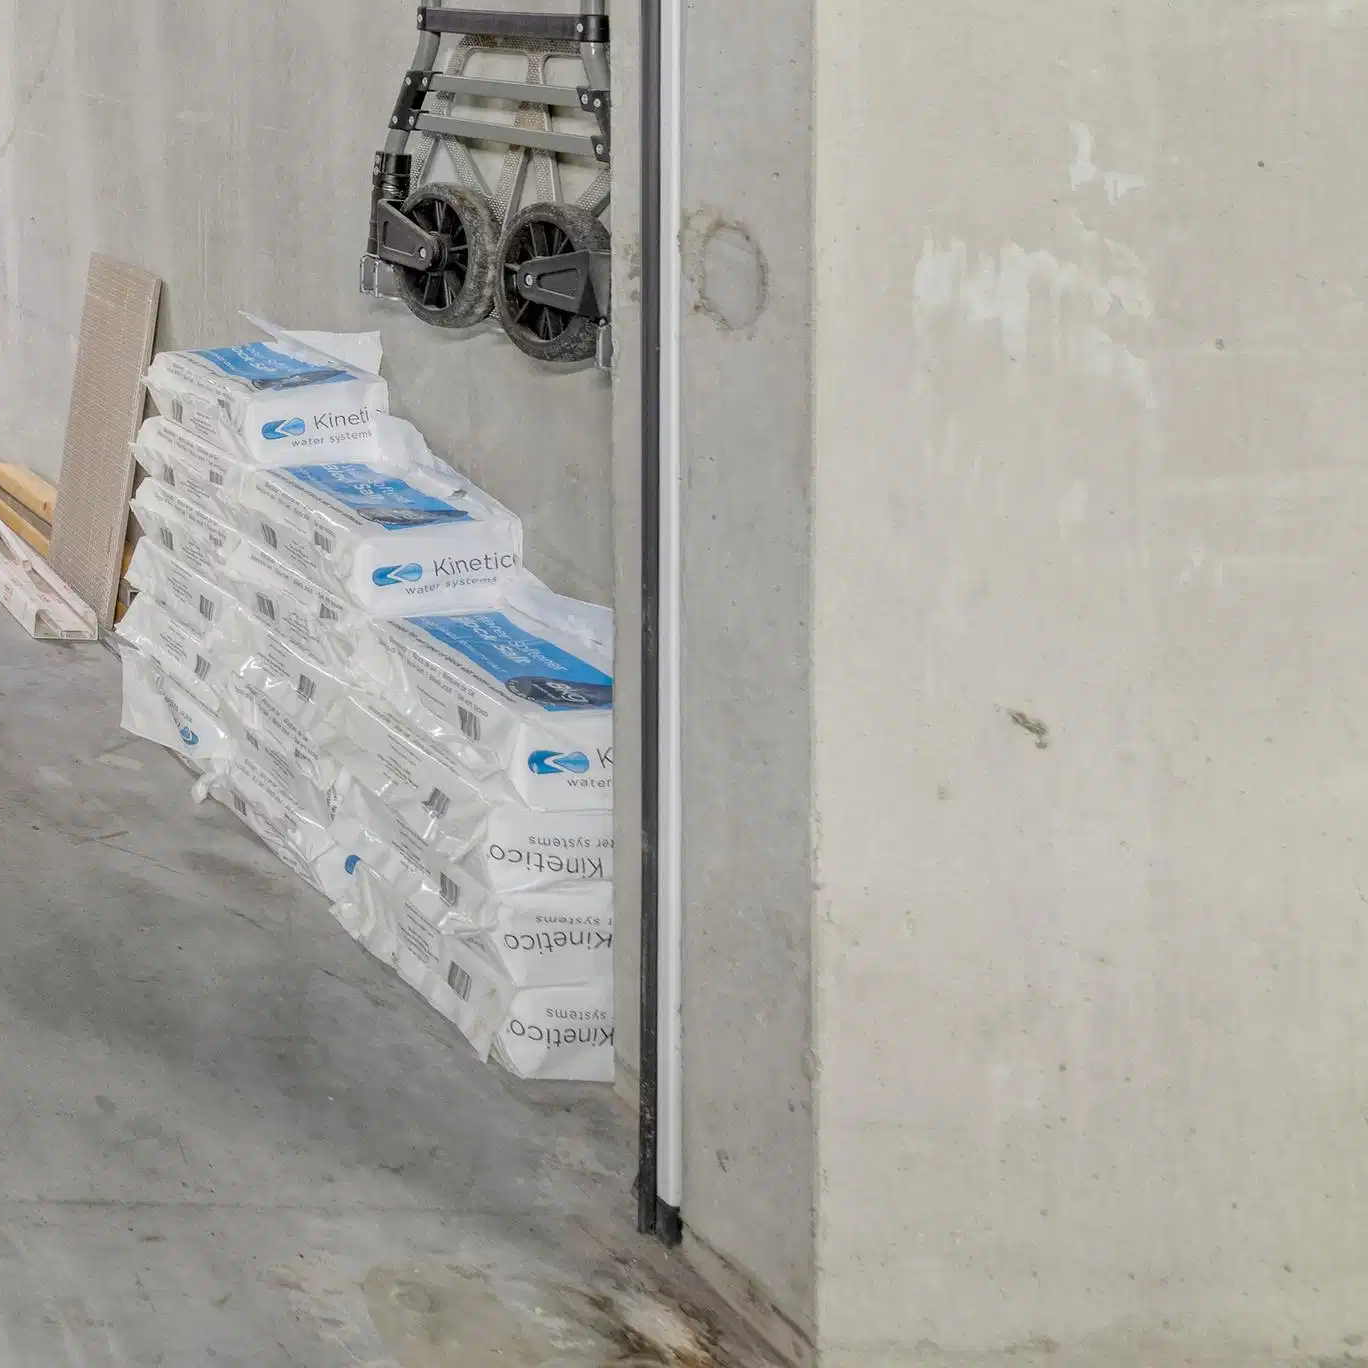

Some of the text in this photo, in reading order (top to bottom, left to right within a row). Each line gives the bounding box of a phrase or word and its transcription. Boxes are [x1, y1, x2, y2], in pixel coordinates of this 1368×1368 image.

[313, 406, 384, 429] Kineti
[291, 436, 324, 447] water
[405, 575, 497, 595] water systems
[567, 778, 612, 788] water
[529, 835, 615, 849] ter systems
[489, 844, 604, 878] Kinetico
[535, 915, 601, 926] systems
[504, 931, 612, 955] Kinetico
[546, 1007, 607, 1021] systems
[510, 1019, 615, 1049] Kinetico
